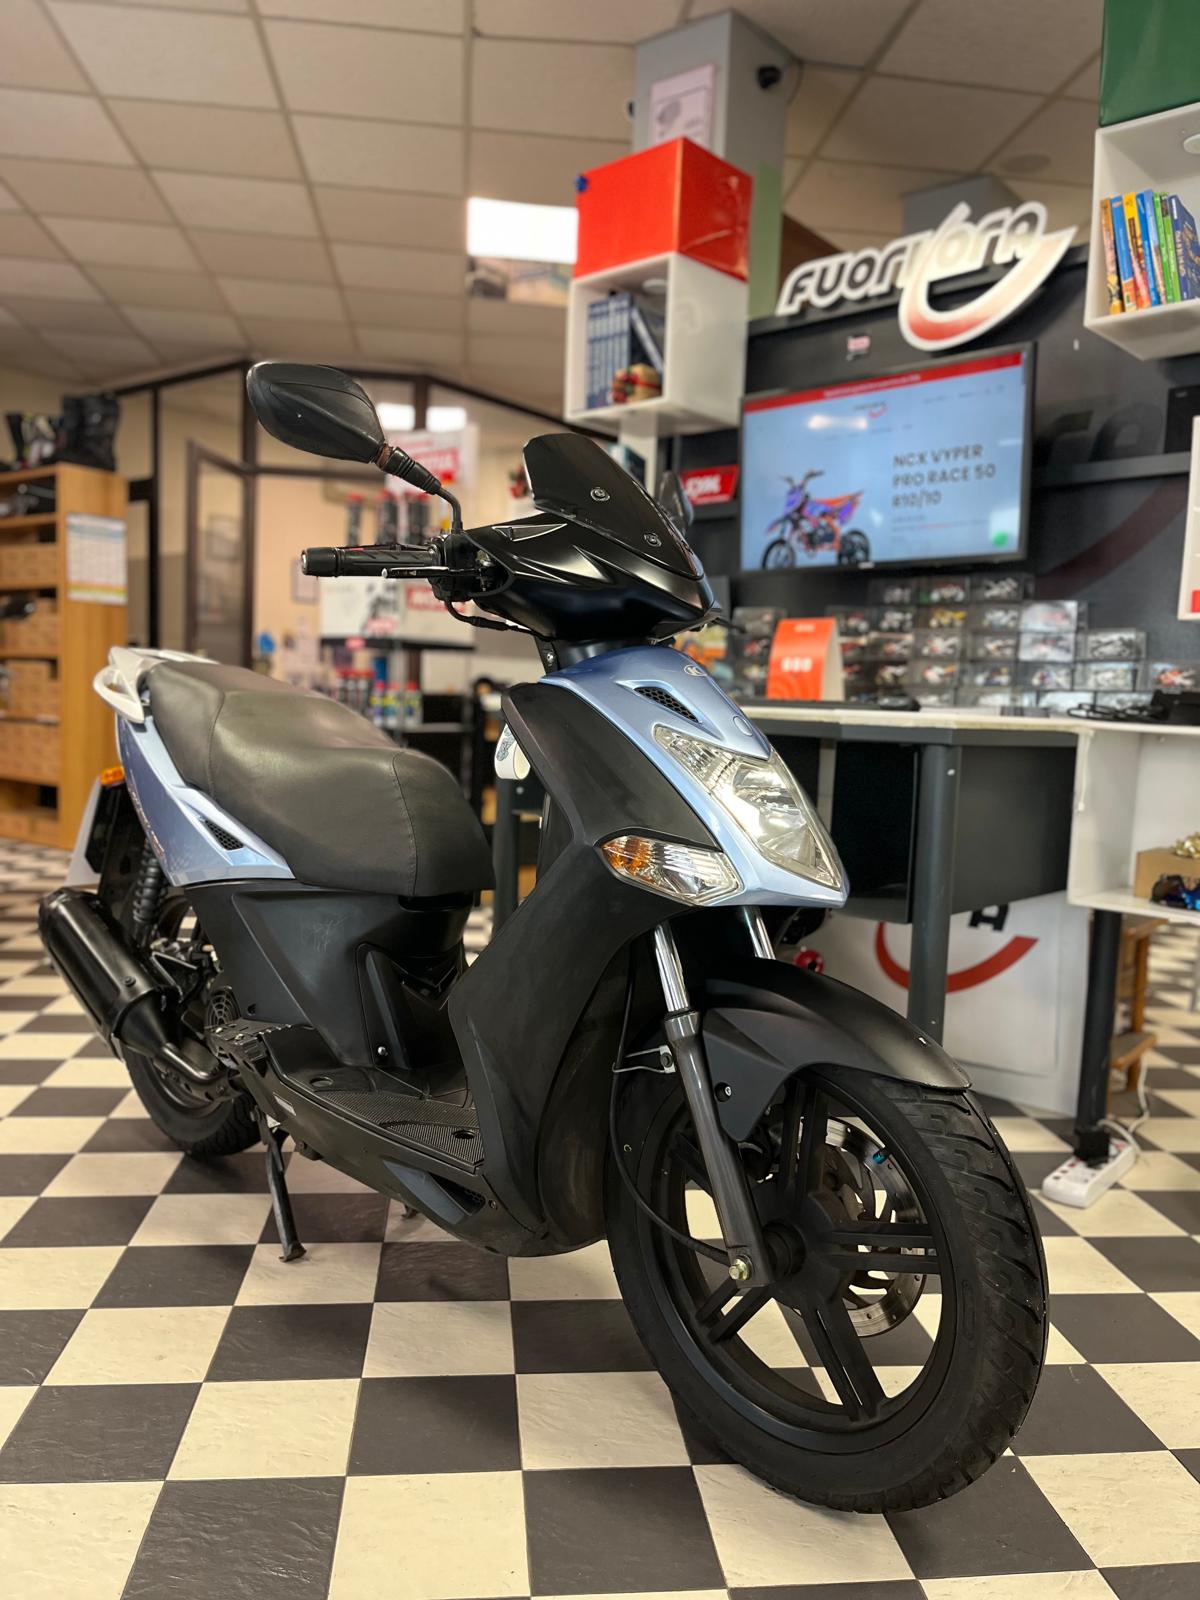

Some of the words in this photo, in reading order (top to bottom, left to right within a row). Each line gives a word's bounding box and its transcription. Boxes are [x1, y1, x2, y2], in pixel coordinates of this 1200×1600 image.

[931, 445, 982, 462] VYPER
[893, 472, 925, 488] PRO
[928, 466, 969, 483] RACE
[974, 463, 996, 480] 50
